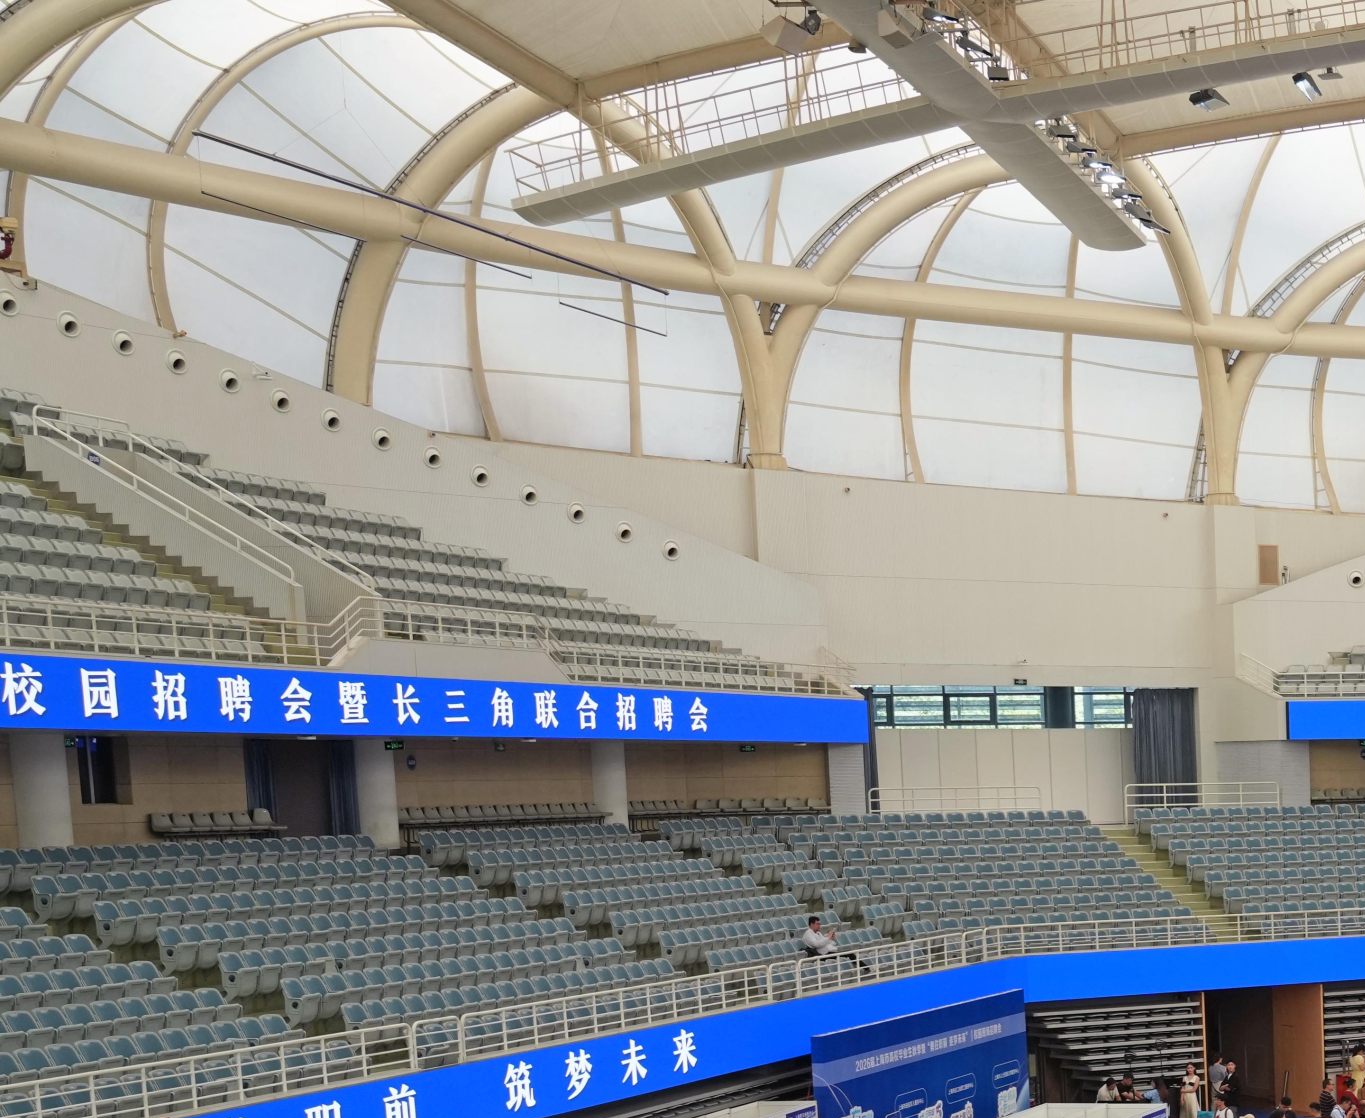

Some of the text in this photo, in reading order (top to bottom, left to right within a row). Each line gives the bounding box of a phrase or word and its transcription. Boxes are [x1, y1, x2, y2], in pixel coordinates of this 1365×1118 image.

[0, 662, 709, 733] 校园招聘会暨长三角联合招聘会
[504, 1029, 699, 1112] 筑梦未来
